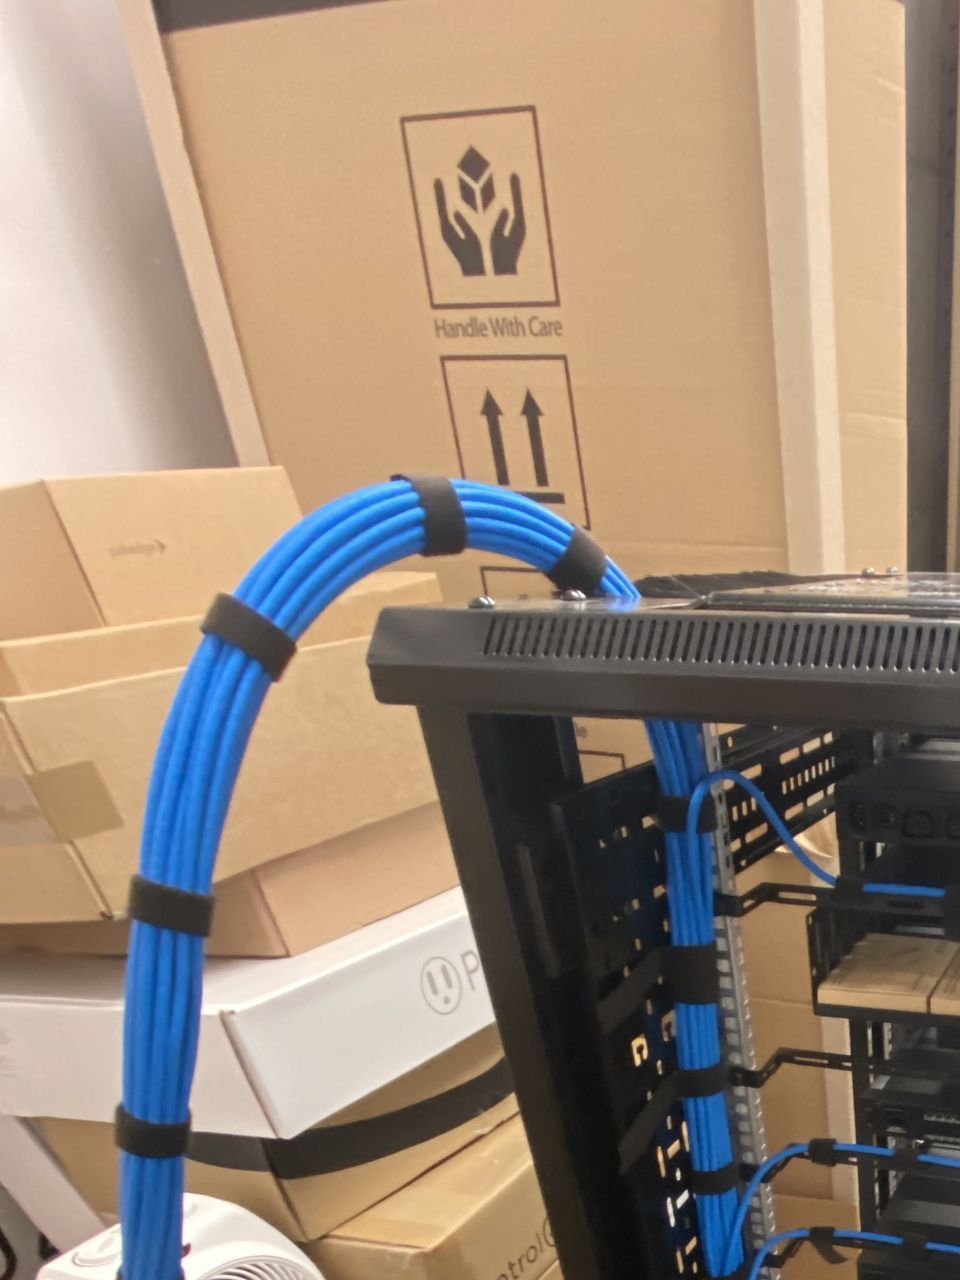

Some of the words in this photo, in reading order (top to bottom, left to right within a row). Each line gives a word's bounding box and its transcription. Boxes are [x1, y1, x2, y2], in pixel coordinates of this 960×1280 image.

[434, 317, 488, 338] Handle
[489, 316, 526, 338] With
[528, 316, 563, 337] Care
